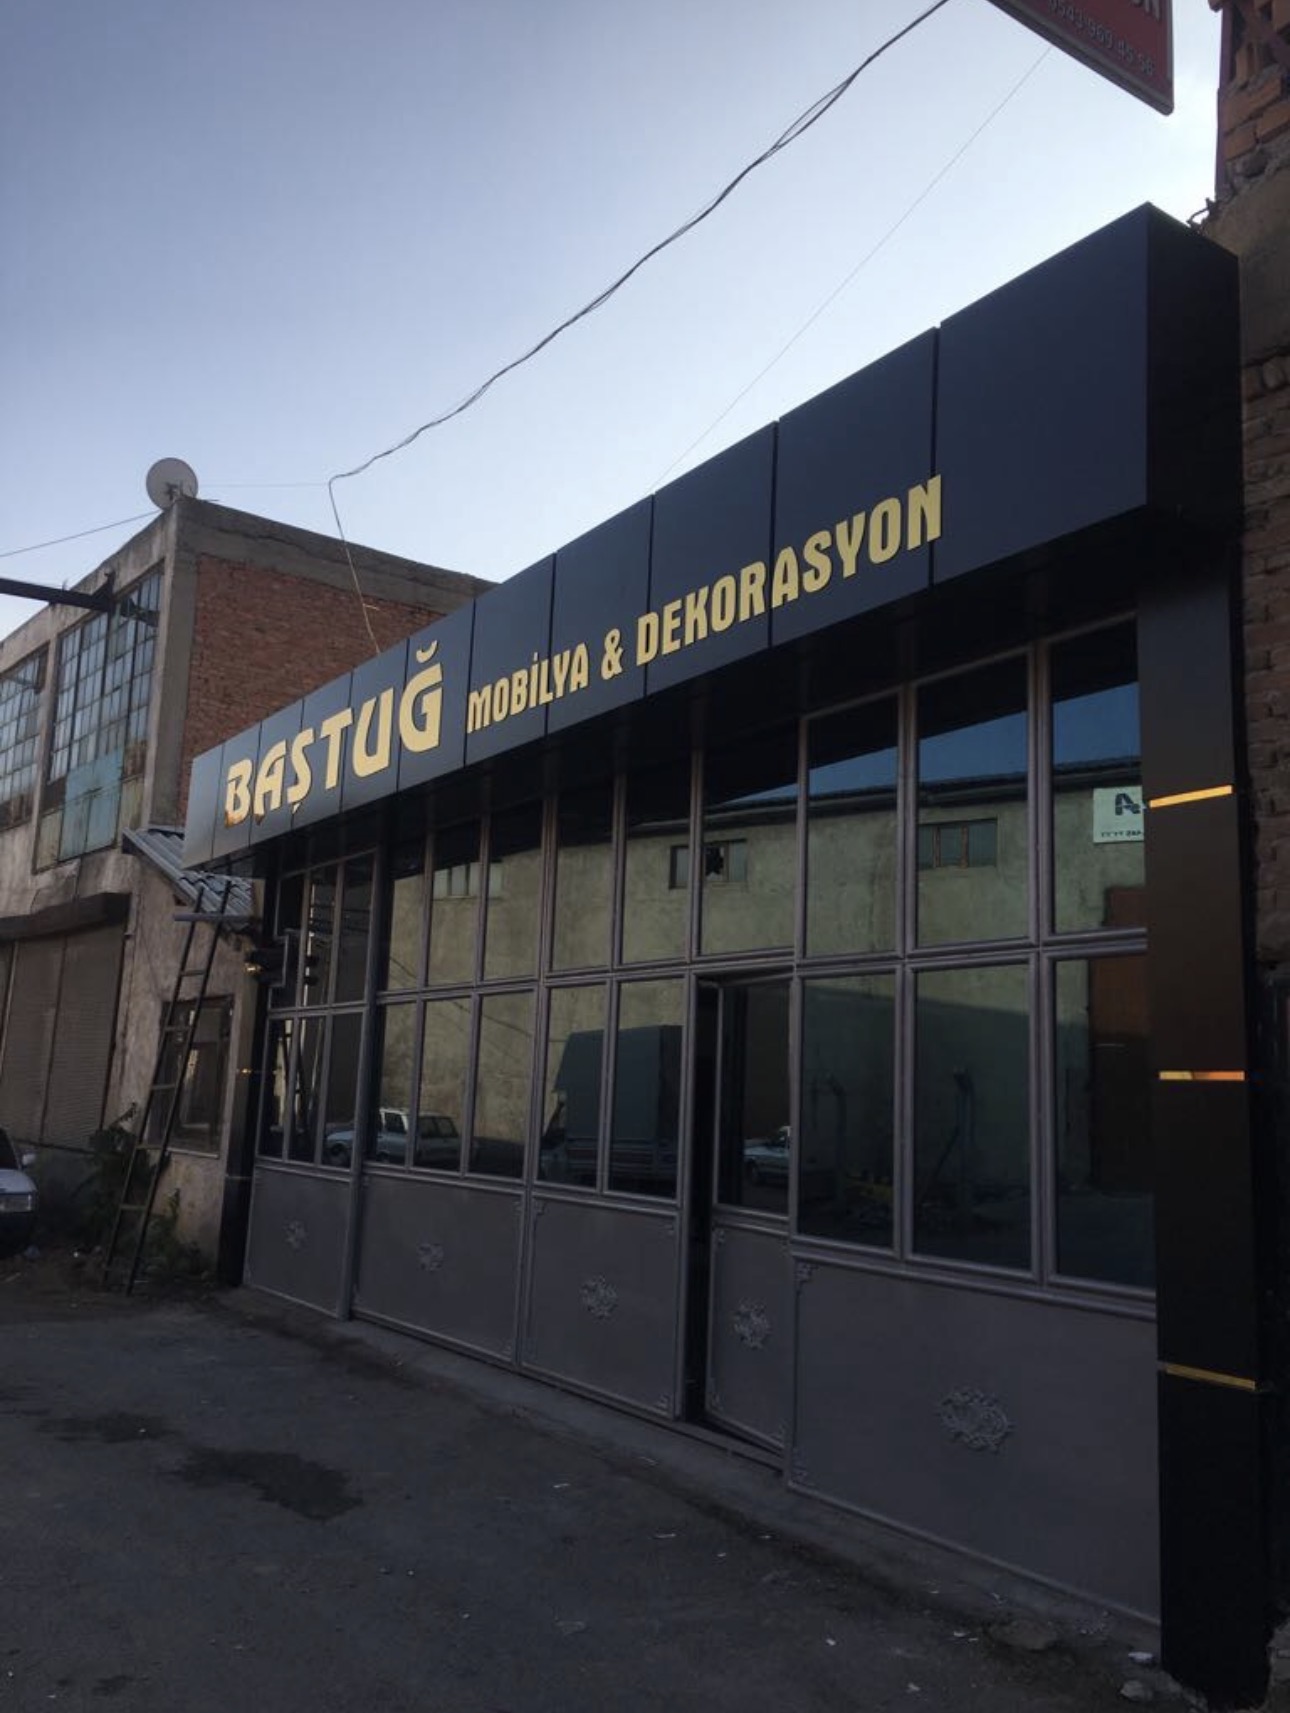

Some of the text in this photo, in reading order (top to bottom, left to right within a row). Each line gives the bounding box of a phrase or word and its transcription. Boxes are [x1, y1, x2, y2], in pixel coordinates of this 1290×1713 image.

[225, 474, 942, 828] BAŞTUĞ MOBİLYA & DEKORASYON
